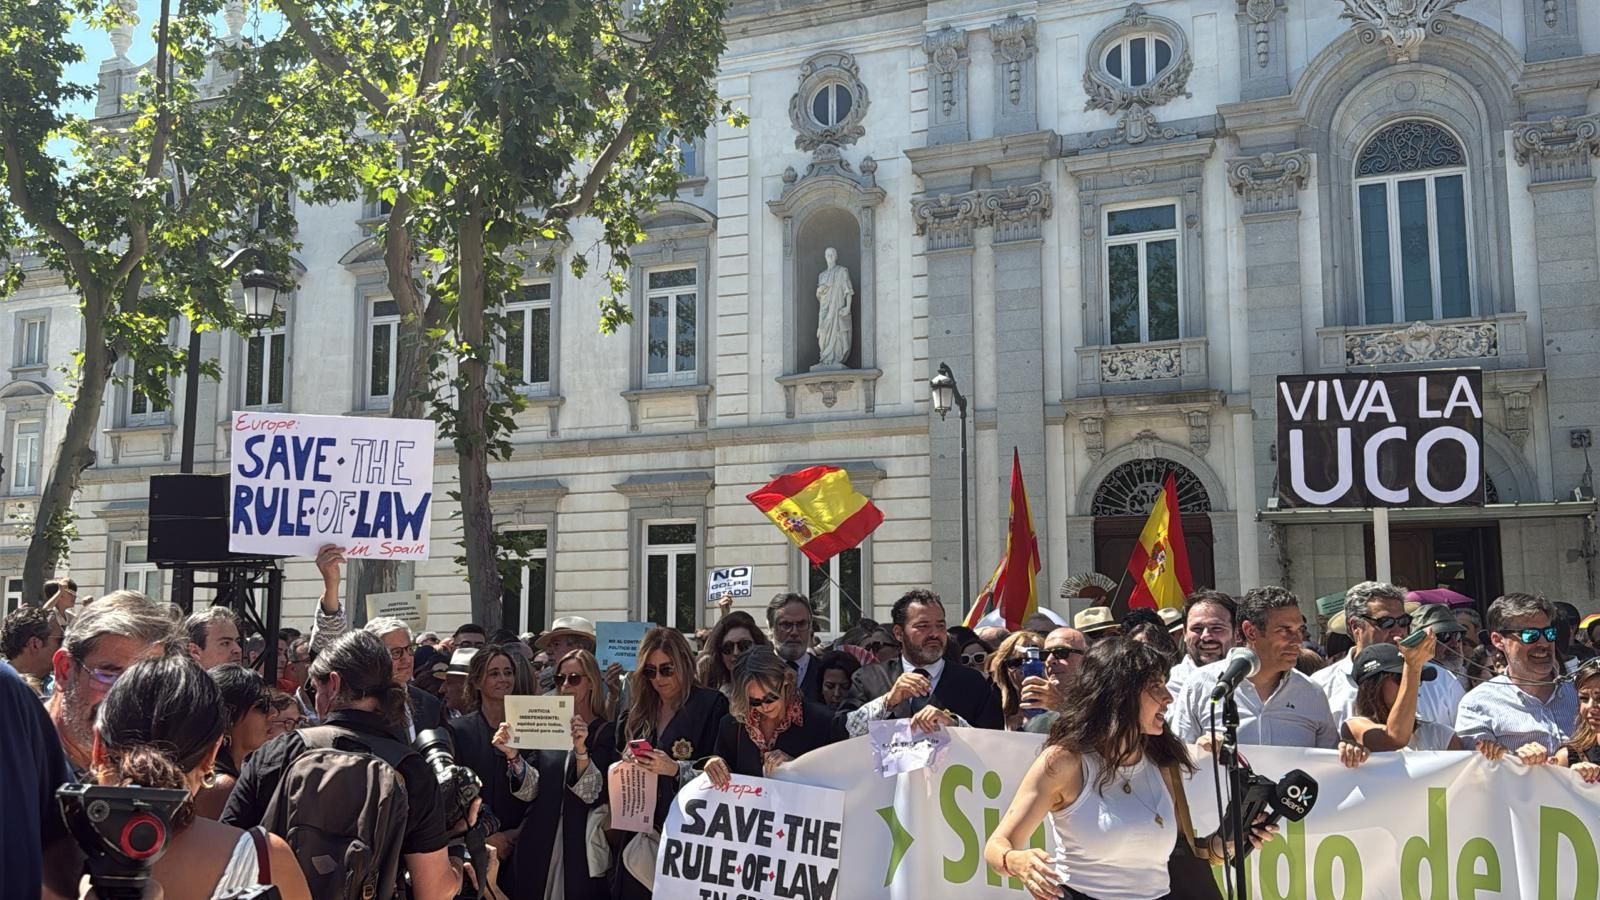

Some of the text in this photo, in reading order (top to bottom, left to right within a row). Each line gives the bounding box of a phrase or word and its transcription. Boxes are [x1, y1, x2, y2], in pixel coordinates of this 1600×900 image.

[235, 414, 300, 434] Europe:
[1280, 376, 1483, 423] VIVA LA
[238, 434, 416, 486] SAVE THE
[1289, 426, 1480, 505] UCO
[232, 485, 432, 541] RULE OF LAW
[347, 542, 425, 557] in Spain
[712, 581, 748, 589] GOLPE
[713, 568, 748, 581] NO
[680, 798, 841, 859] SAVE THE
[1281, 797, 1305, 814] diario
[1400, 787, 1501, 900] de
[662, 838, 839, 900] RULE OF LAW
